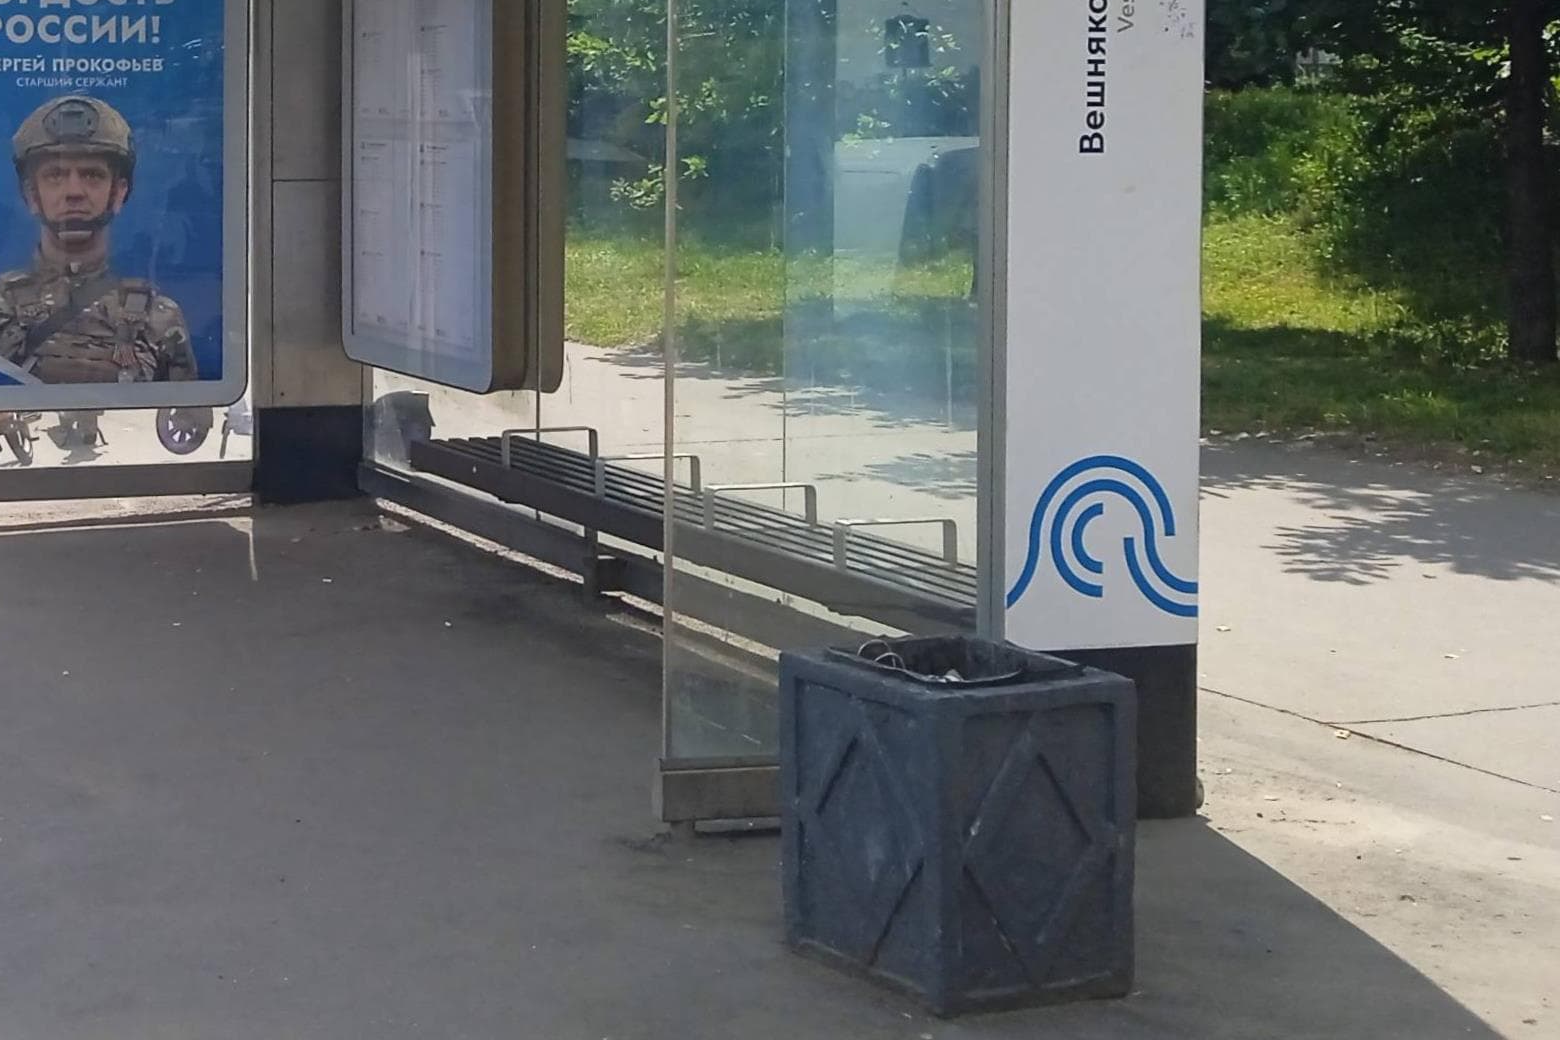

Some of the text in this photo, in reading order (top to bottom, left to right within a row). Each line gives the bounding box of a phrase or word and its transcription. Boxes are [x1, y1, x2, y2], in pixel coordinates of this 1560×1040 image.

[52, 57, 165, 73] ПРОКОФЬЕВ
[15, 76, 129, 88] СТАРШИЙ СЕРЖАНТ
